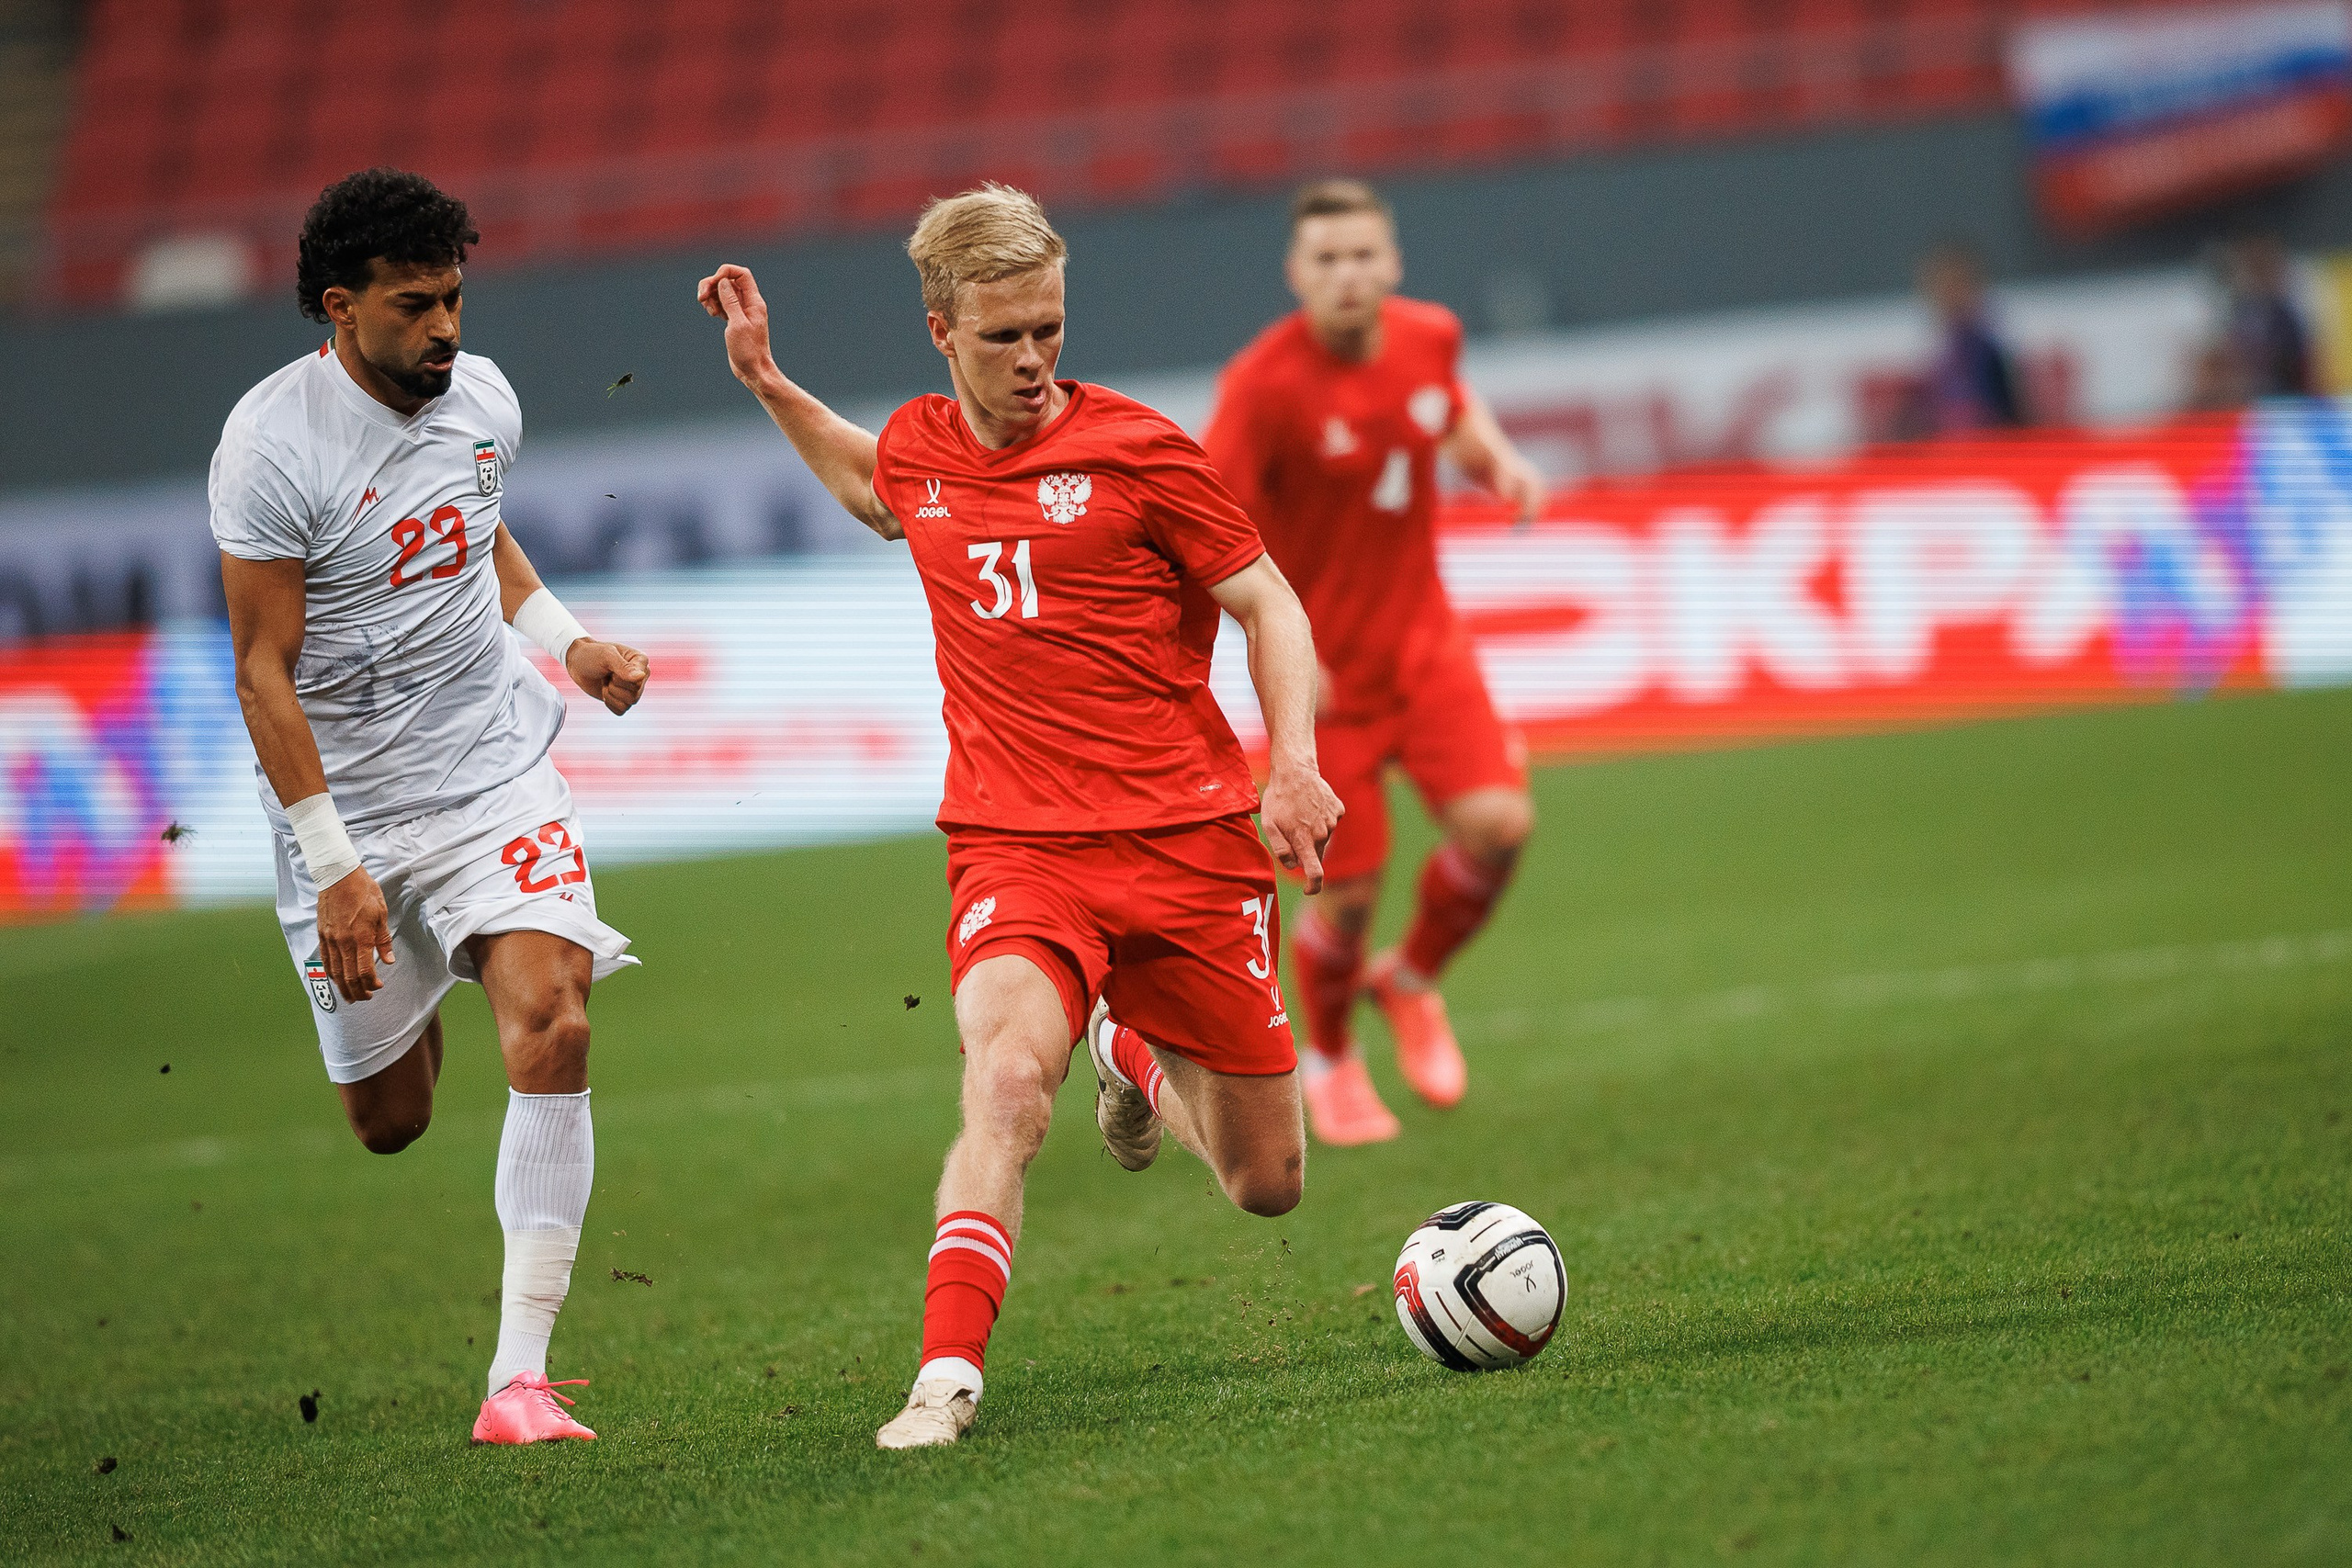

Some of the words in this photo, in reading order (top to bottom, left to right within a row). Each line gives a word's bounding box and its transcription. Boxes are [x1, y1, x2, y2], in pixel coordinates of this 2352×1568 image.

[390, 504, 469, 588] 23
[915, 506, 952, 518] JOGEL
[967, 539, 1039, 619] 31
[501, 820, 586, 894] 23
